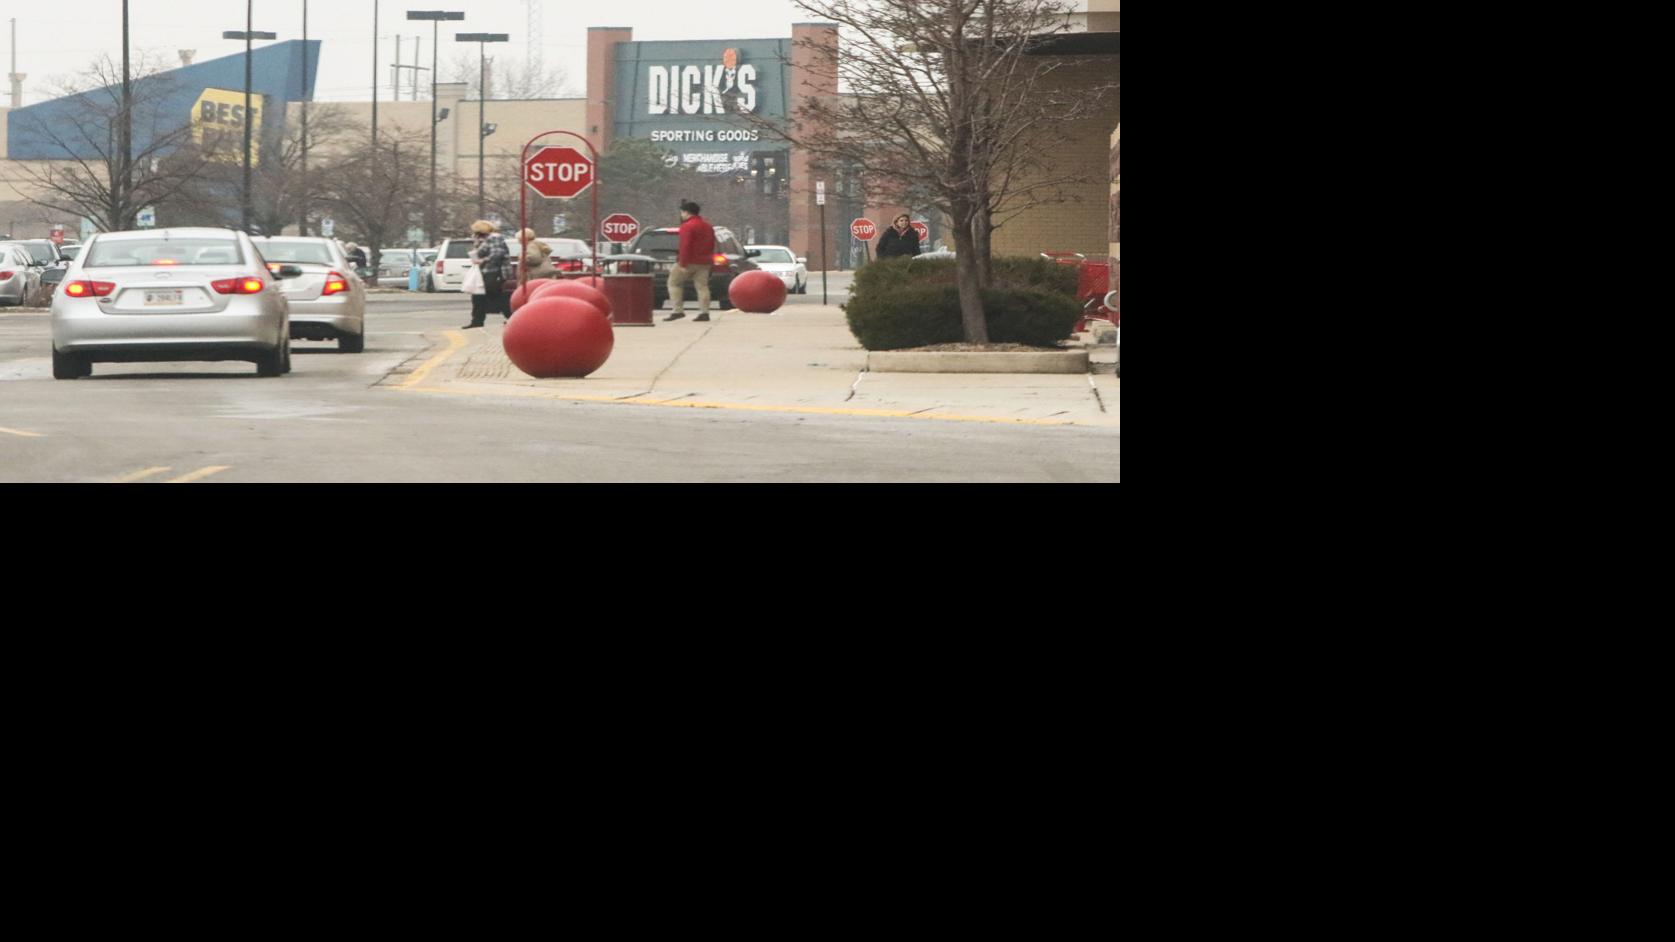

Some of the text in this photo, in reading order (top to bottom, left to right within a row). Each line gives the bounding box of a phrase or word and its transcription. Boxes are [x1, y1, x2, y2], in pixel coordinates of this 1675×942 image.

[648, 64, 756, 114] DICK'S
[651, 130, 759, 141] SPORTING GOODS
[530, 163, 588, 182] STOP
[604, 222, 637, 234] STOP
[853, 225, 874, 235] STOP
